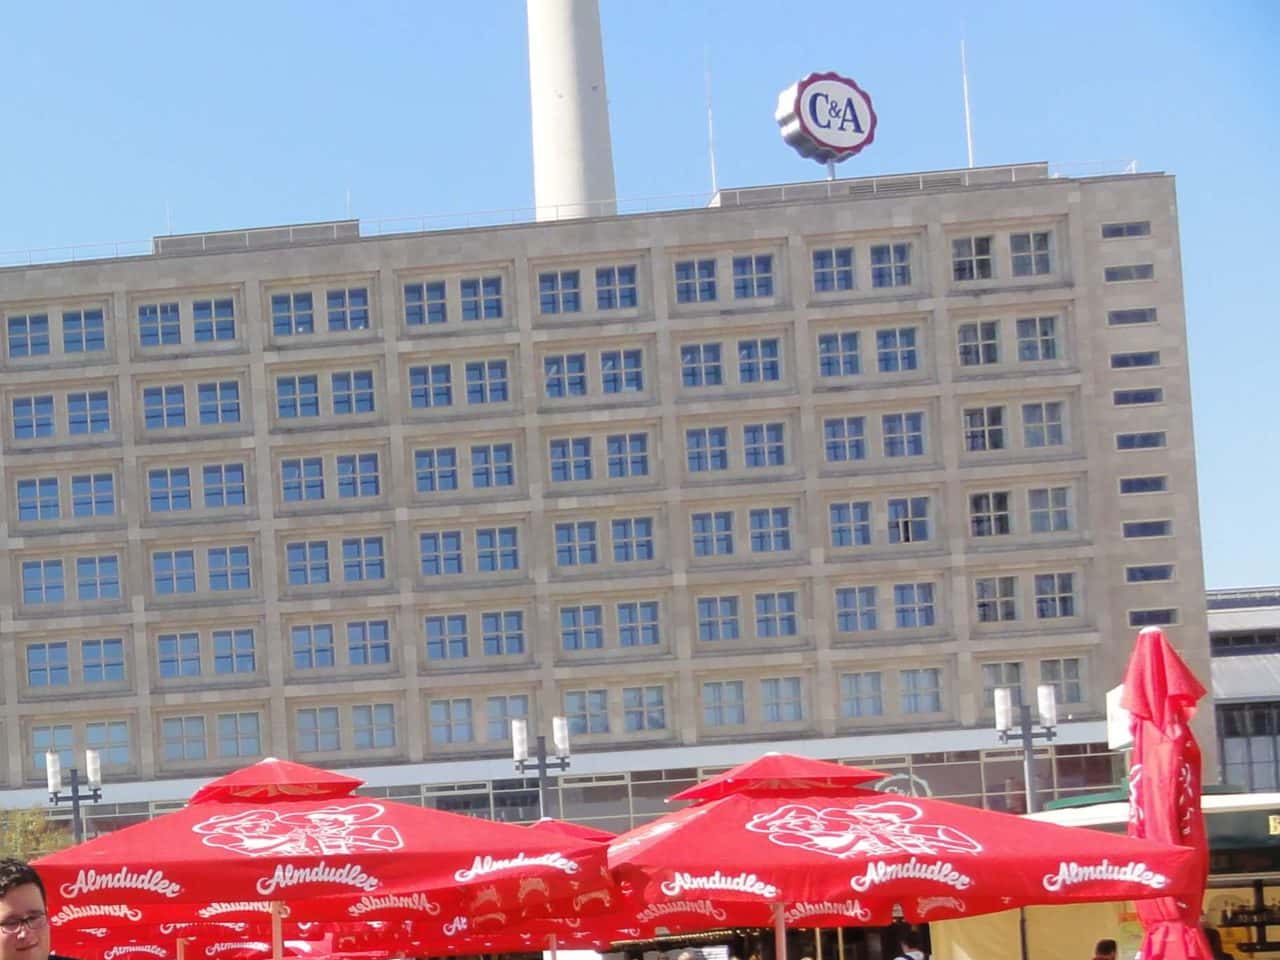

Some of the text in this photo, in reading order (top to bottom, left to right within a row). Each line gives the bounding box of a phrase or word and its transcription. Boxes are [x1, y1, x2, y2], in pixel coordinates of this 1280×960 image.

[808, 92, 865, 134] C&A
[60, 867, 181, 898] Almdudler
[256, 861, 379, 895] Almdudler
[454, 852, 579, 882] Almdudler
[850, 856, 970, 892] Almdudler
[1042, 859, 1166, 892] Almdudler
[661, 870, 777, 898] Almdudler
